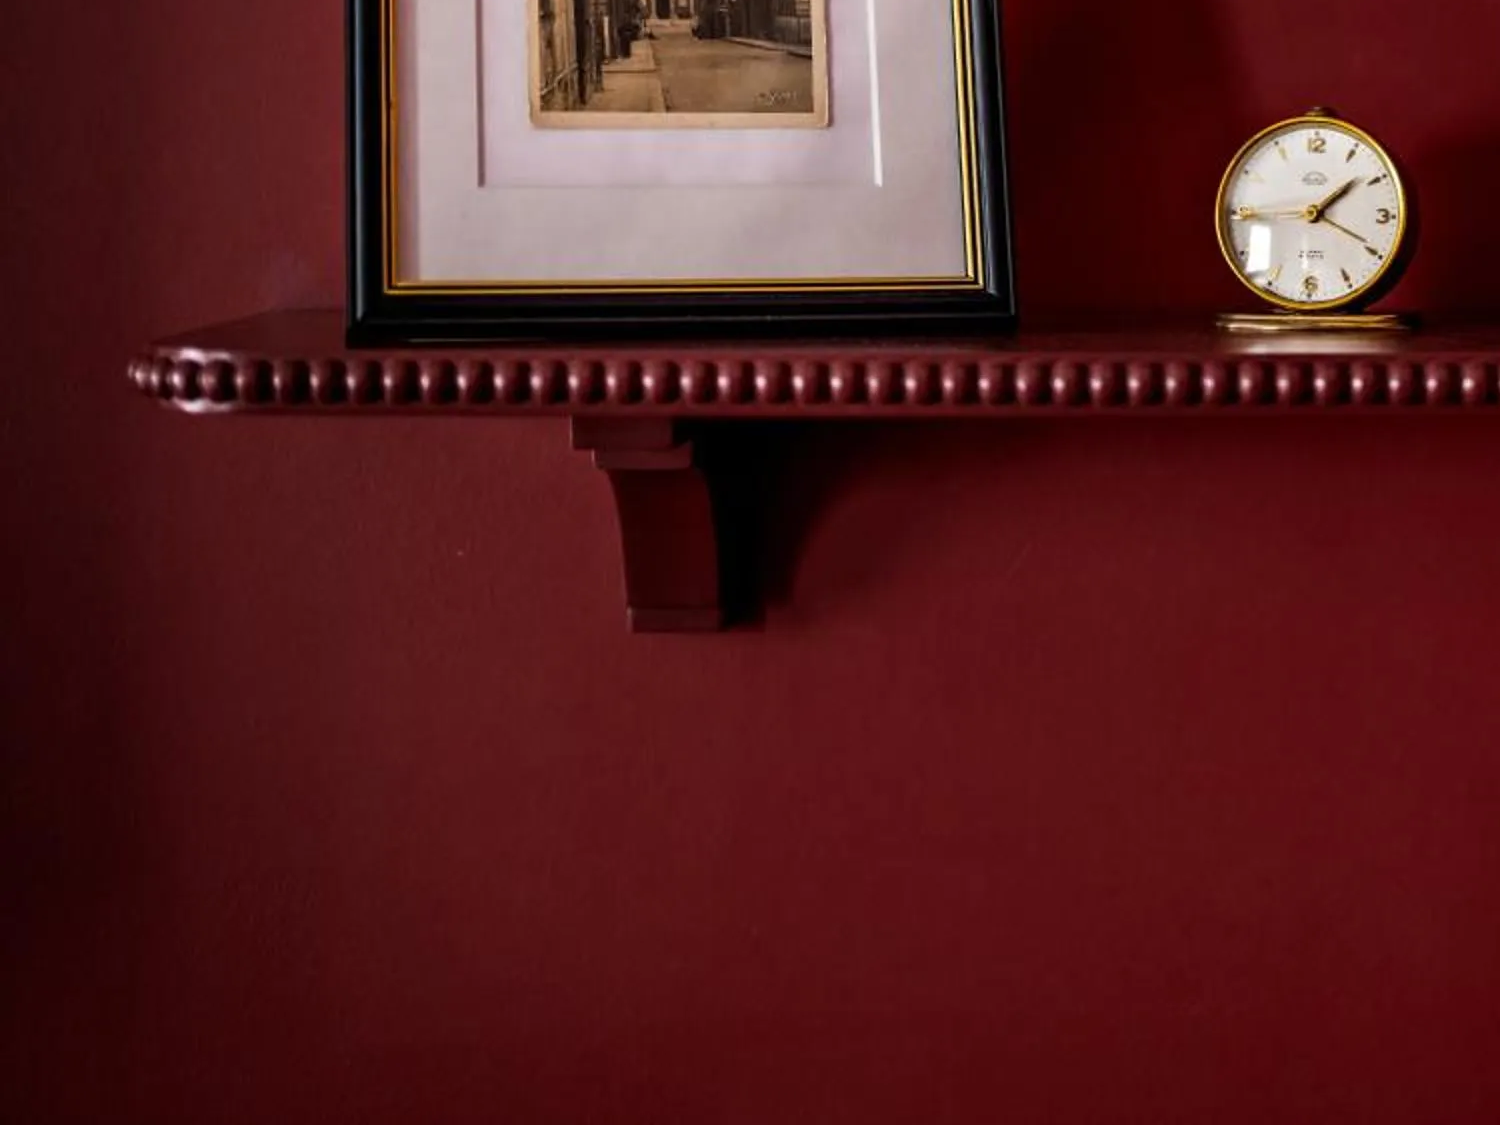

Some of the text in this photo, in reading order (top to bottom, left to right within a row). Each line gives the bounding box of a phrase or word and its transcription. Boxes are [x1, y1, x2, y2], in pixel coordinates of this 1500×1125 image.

[1307, 138, 1326, 153] 12
[1376, 208, 1390, 224] 3
[1303, 276, 1318, 292] 6
